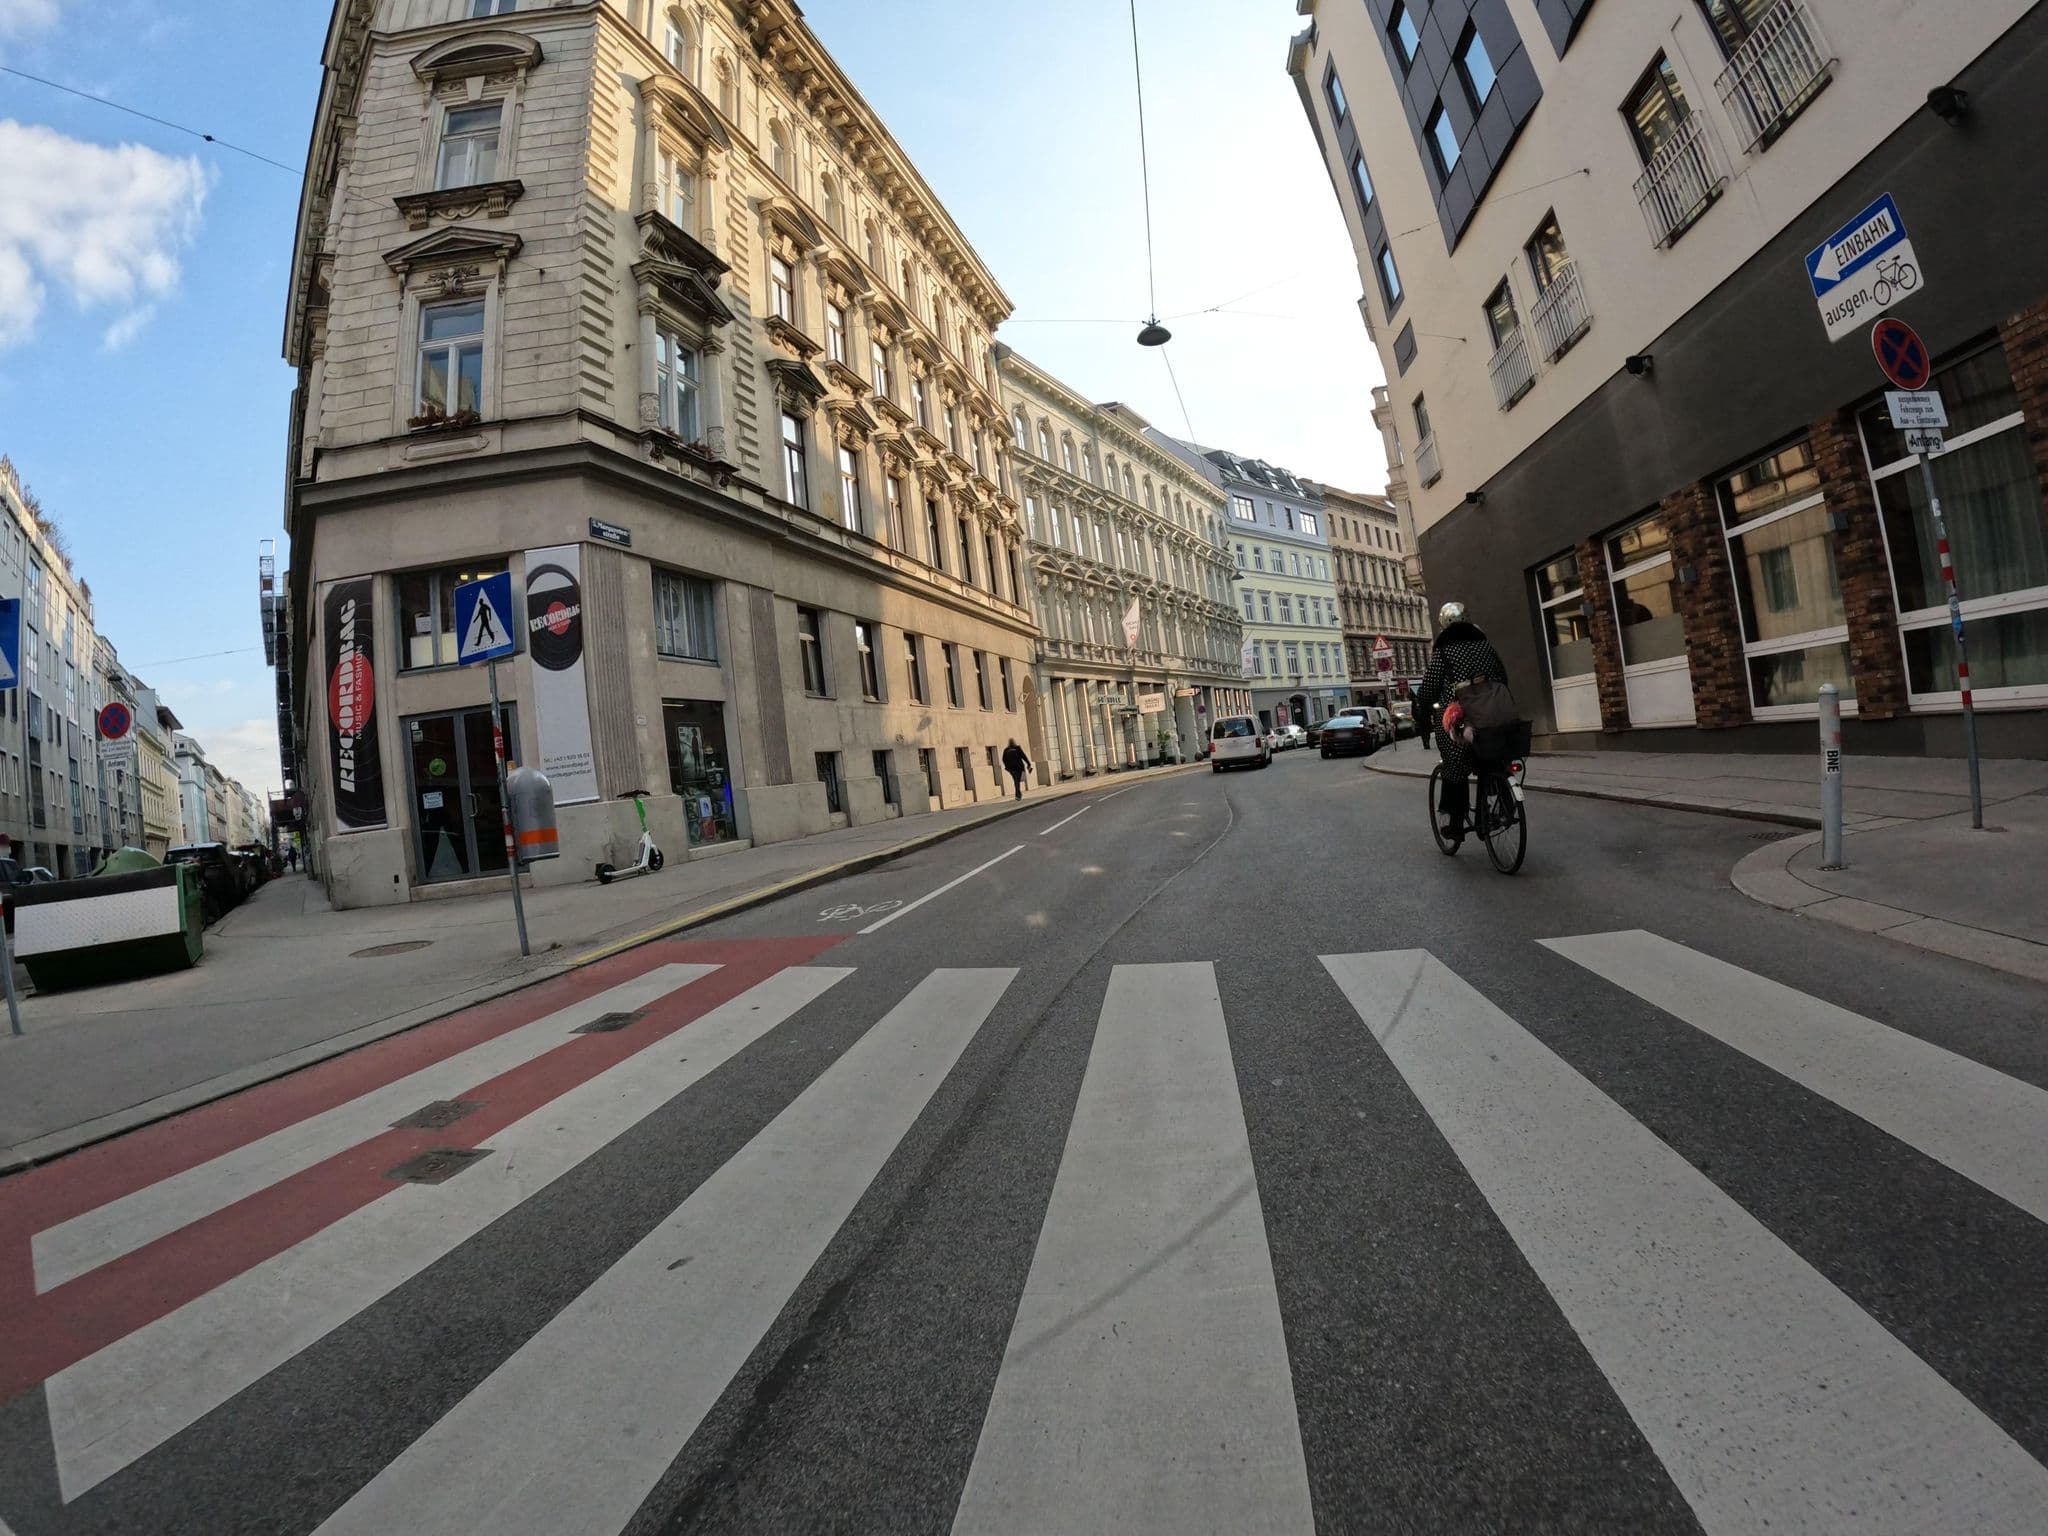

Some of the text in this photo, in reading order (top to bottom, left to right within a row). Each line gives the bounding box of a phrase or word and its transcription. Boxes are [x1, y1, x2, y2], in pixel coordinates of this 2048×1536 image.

[1835, 214, 1890, 267] EINBAHN
[1825, 289, 1873, 326] ausgen.
[1909, 434, 1940, 449] Anfang
[529, 603, 580, 632] RECORDBAG
[355, 644, 364, 691] FASHION
[339, 599, 356, 792] RECORDBAG
[355, 694, 362, 702] &
[1826, 750, 1839, 772] BNE
